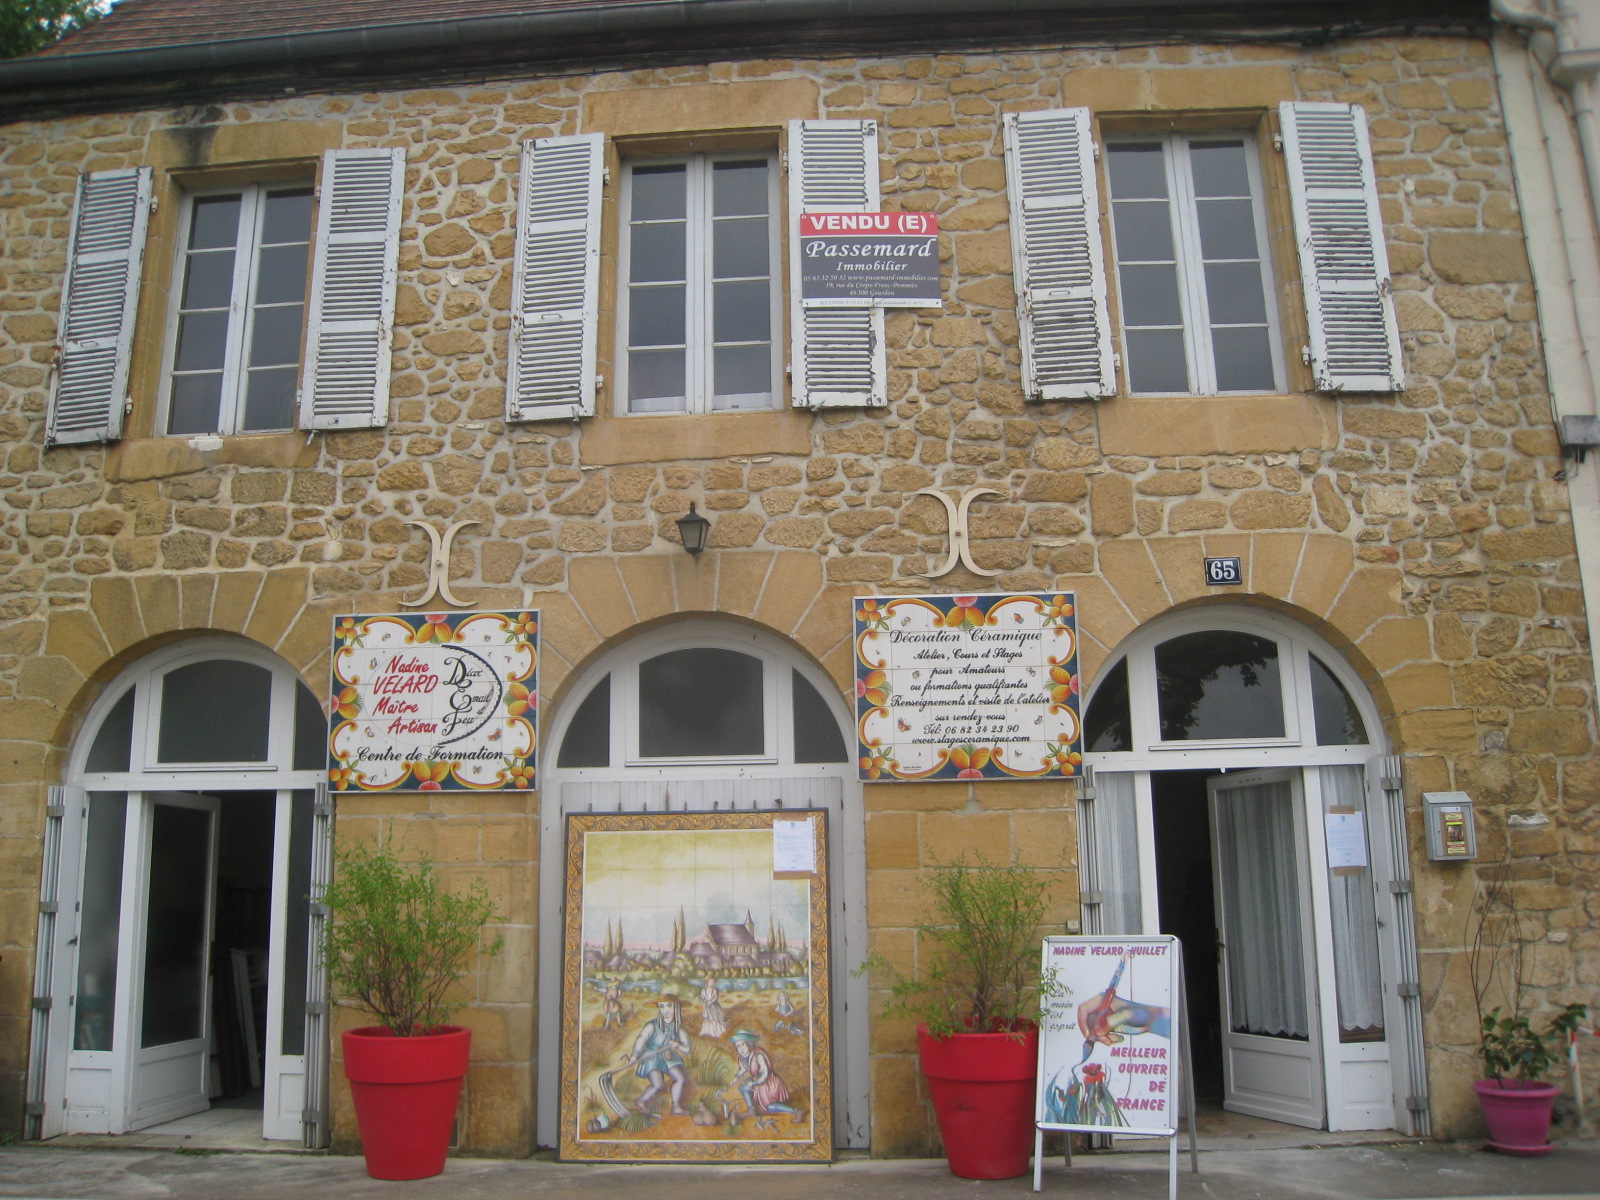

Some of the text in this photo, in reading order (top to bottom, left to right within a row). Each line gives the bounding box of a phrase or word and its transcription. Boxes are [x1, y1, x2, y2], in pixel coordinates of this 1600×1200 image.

[810, 215, 927, 233] VENDU (E)
[805, 238, 937, 258] Passemard
[836, 261, 908, 271] Immobilier
[1210, 561, 1235, 580] 65
[890, 628, 1042, 647] Décoration Céramique
[952, 648, 978, 659] Cours
[981, 649, 989, 659] et
[992, 648, 1023, 663] Stages
[385, 654, 429, 674] Nadine
[930, 663, 1005, 678] pour Amateurs
[373, 674, 439, 695] VELARD
[920, 679, 972, 696] formations
[974, 679, 1028, 696] qualifiantes
[372, 696, 418, 716] Maître
[890, 693, 1050, 712] Renseignements et visite de l'atelier
[387, 716, 438, 735] Artisan
[923, 724, 1019, 735] Tél: 06 82 34 23 90
[912, 734, 1030, 748] www.stagesceramique.com
[357, 745, 504, 761] Centre de Formation
[1053, 946, 1086, 956] NADINE
[1091, 946, 1123, 956] VELARD
[1050, 1022, 1076, 1031] esprit
[1110, 1047, 1167, 1059] MEILLEUR
[1118, 1063, 1167, 1075] OUVRIER
[1149, 1081, 1166, 1093] DE
[1116, 1098, 1166, 1111] FRANCE
